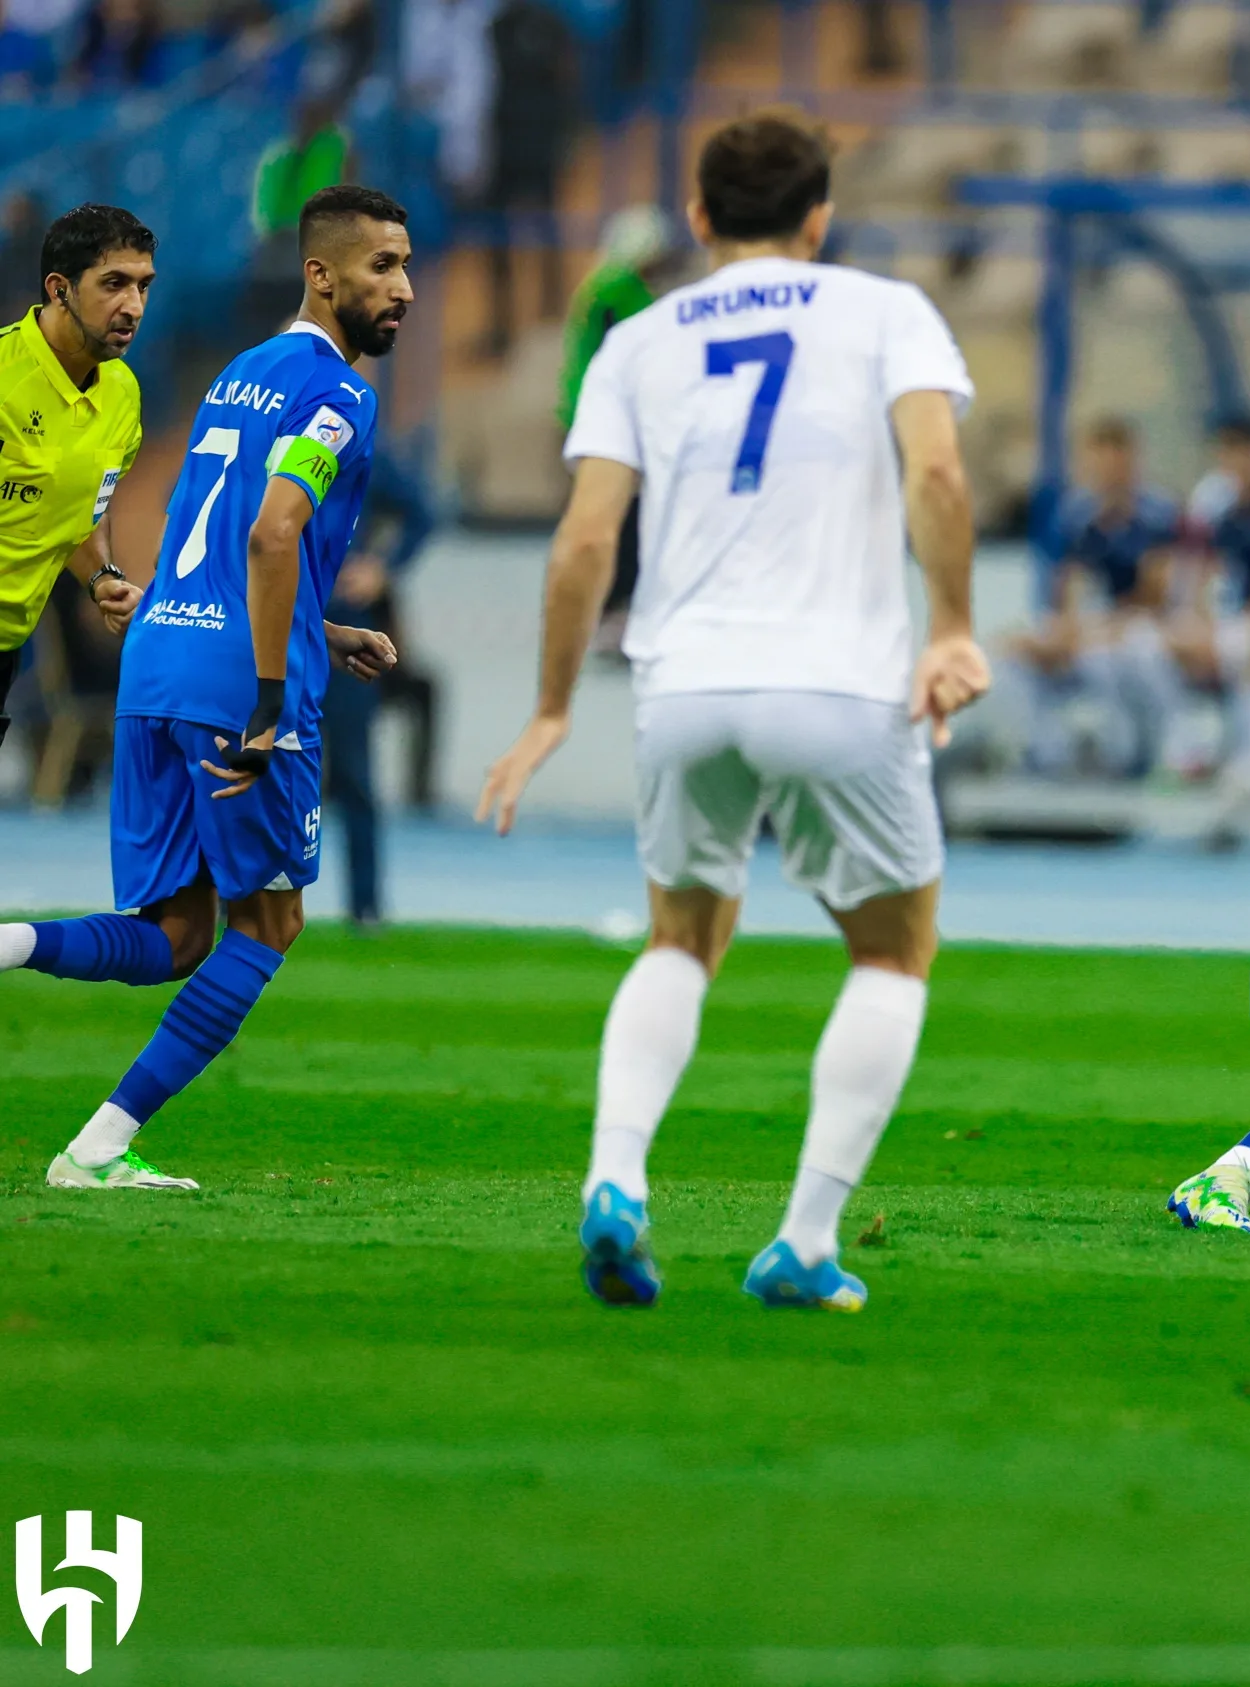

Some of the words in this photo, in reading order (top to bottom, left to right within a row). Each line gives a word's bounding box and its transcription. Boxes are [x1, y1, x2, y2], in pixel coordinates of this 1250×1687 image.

[677, 280, 819, 325] URUNOV
[706, 331, 795, 494] 7
[102, 472, 118, 487] FIF
[176, 427, 240, 579] 7
[151, 614, 224, 631] FOUNDATION
